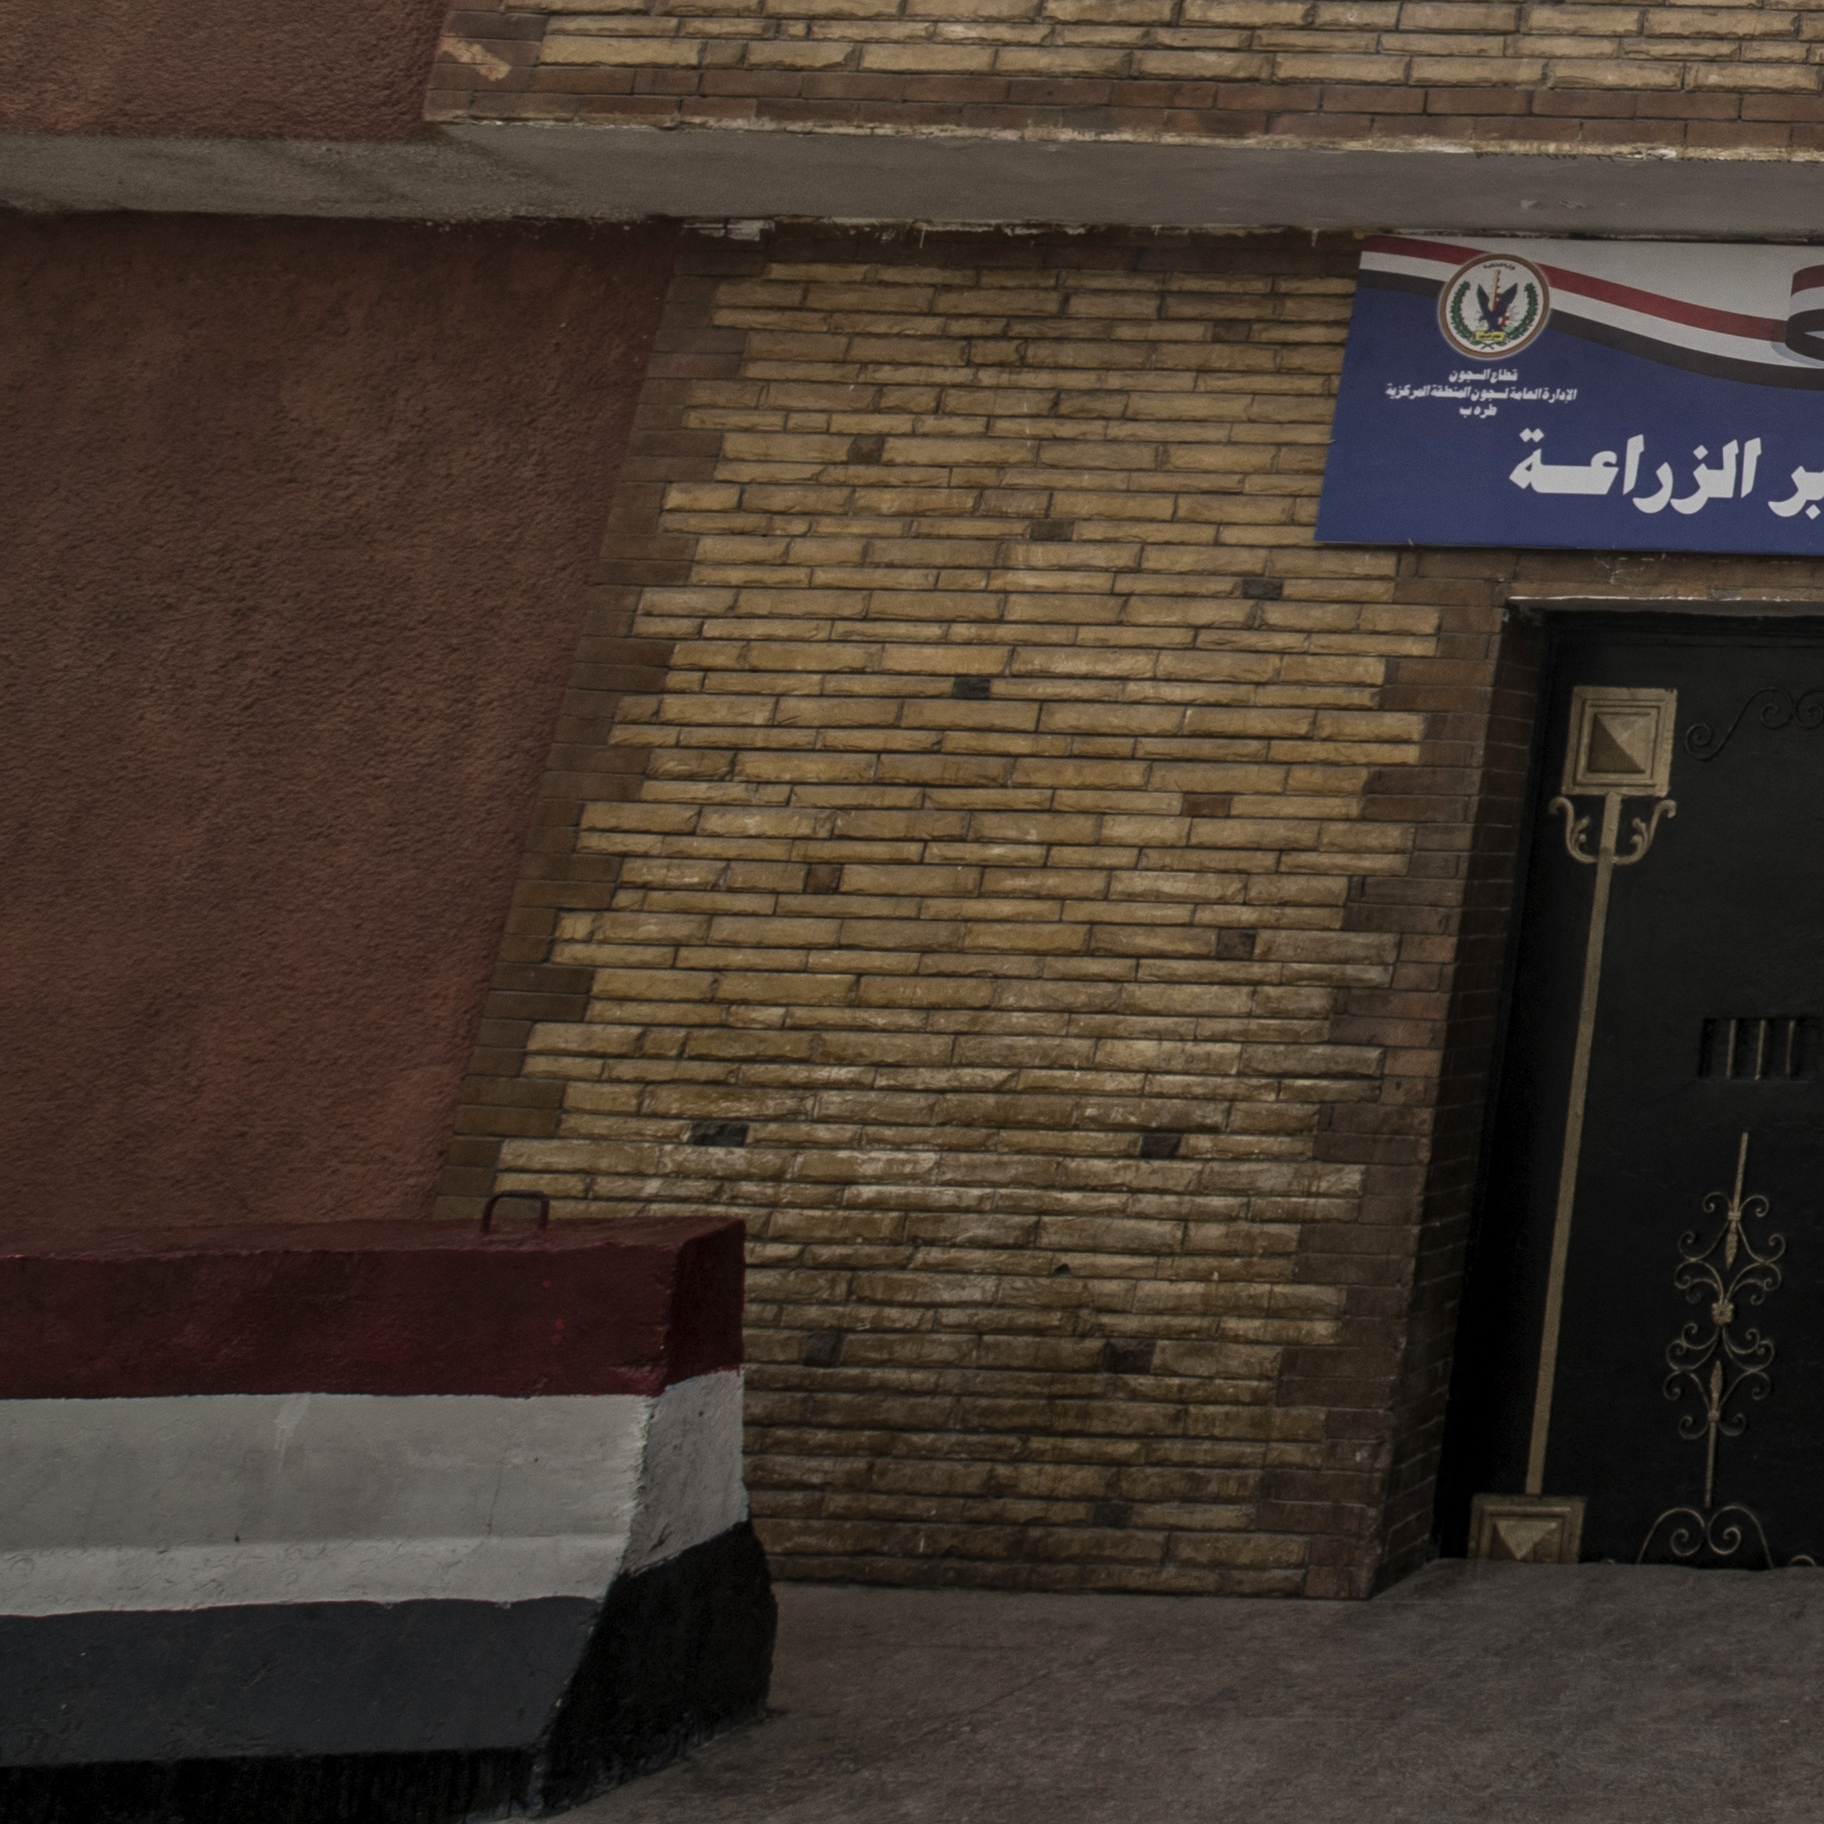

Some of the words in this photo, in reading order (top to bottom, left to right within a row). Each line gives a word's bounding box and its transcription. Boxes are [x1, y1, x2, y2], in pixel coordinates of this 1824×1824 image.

[1448, 368, 1491, 383] السجون
[1490, 368, 1518, 384] قطاع
[1385, 382, 1431, 400] المركزية
[1430, 384, 1471, 399] المنطقة
[1470, 387, 1509, 402] لسجون
[1509, 386, 1542, 401] العامة
[1508, 427, 1762, 515] الزراعة
